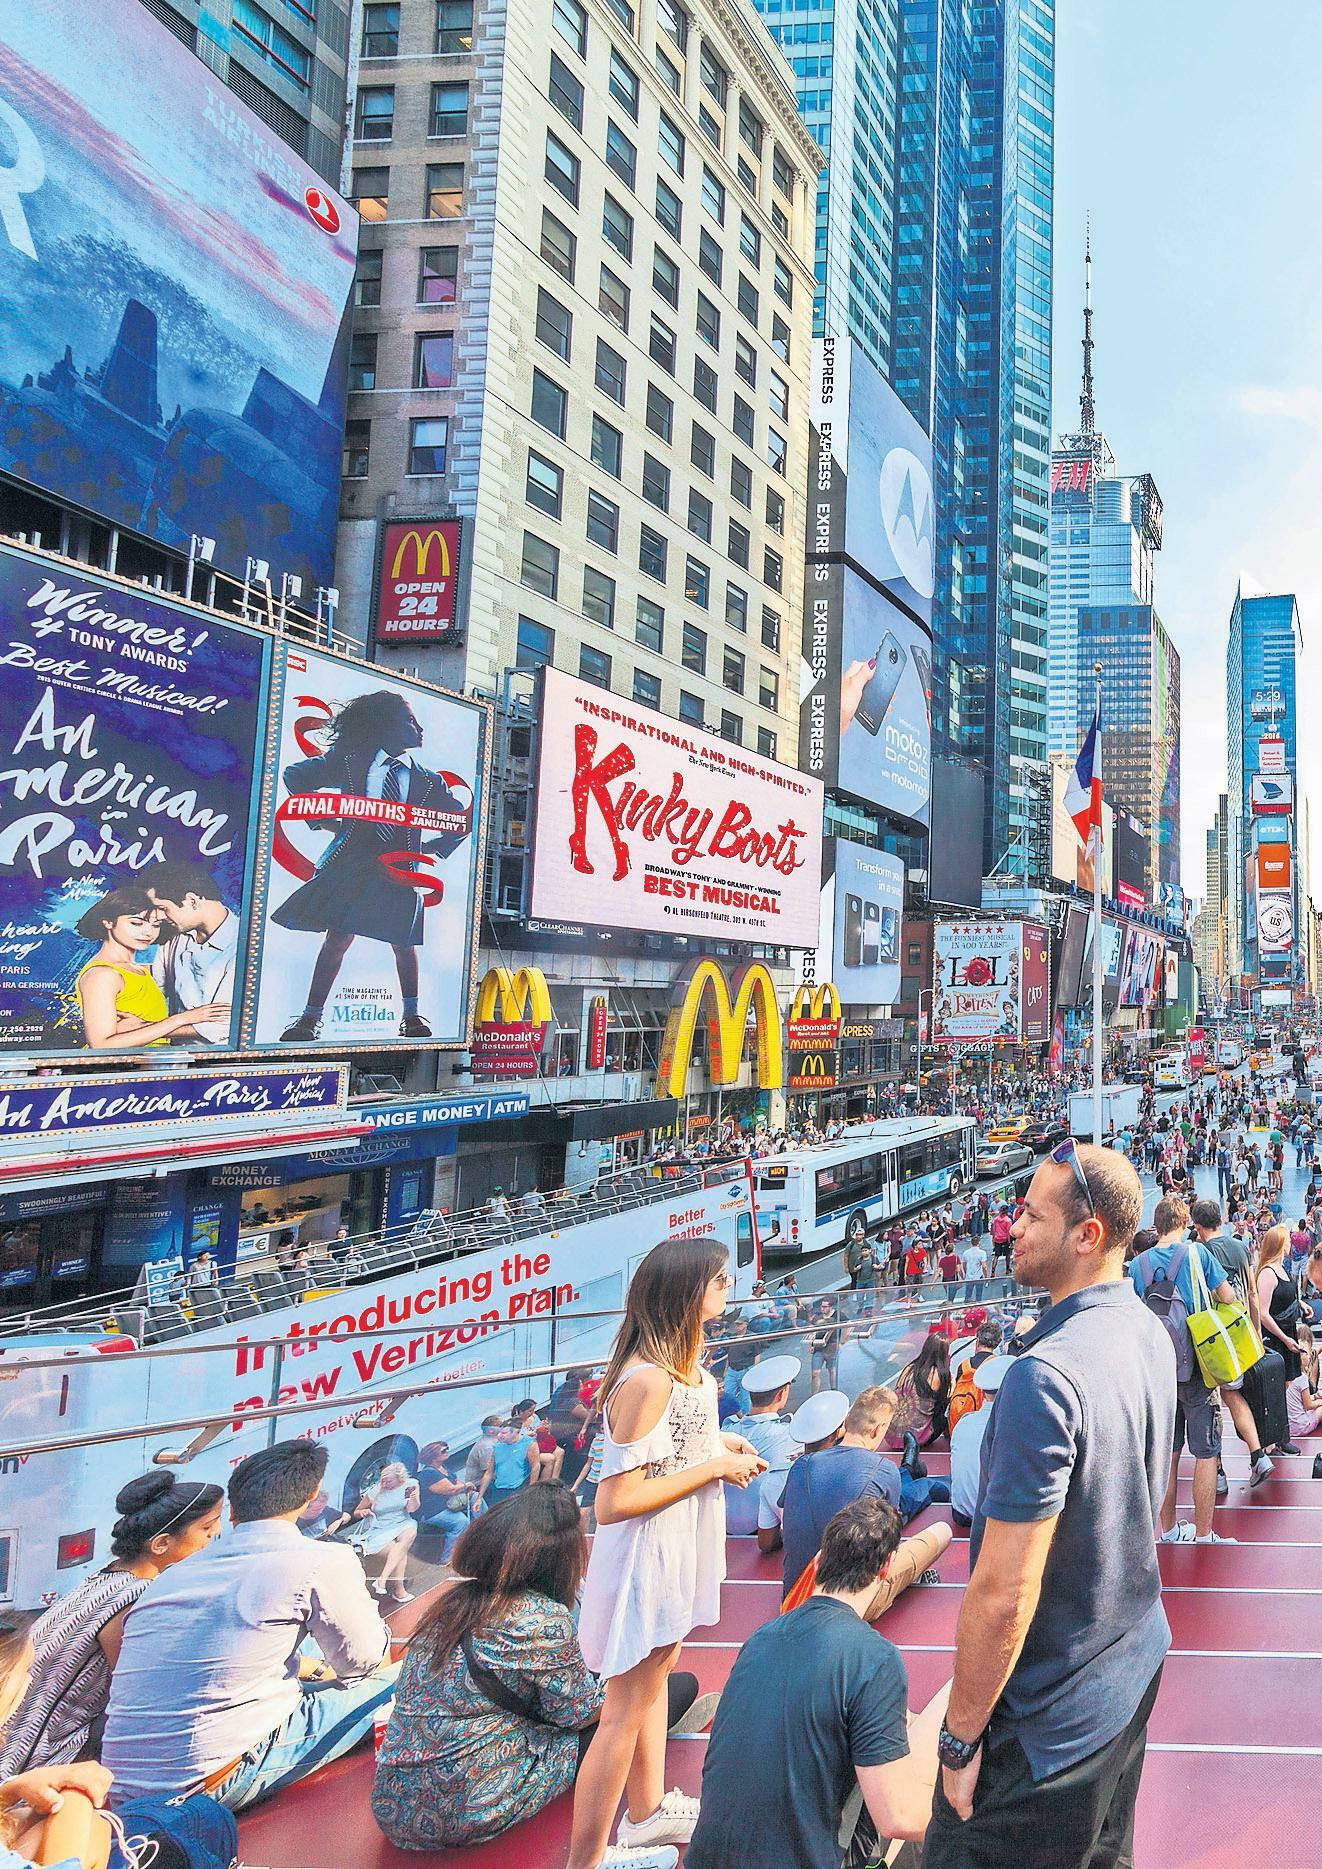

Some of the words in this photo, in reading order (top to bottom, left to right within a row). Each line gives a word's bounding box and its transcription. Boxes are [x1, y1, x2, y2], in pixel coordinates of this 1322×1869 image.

[205, 86, 300, 185] TURKISH
[202, 107, 299, 200] AIRLINES
[823, 338, 834, 403] EXPRESS
[817, 422, 831, 491] EXPRESS
[395, 582, 445, 594] OPEN
[398, 597, 438, 615] 24
[27, 578, 209, 656] Winner!
[385, 619, 449, 631] HOURS
[31, 617, 64, 638] 4
[69, 628, 116, 653] TONY
[120, 643, 188, 673] AWARDS
[812, 599, 828, 679] EXPRESS
[0, 642, 91, 681] Best
[95, 667, 229, 714] Musical!
[52, 678, 72, 688] OUTER
[97, 689, 117, 700] CIRCLE
[123, 696, 142, 706] DRAMA
[143, 700, 162, 710] LEAGUE
[1255, 691, 1280, 702] 5:29
[12, 686, 98, 759] An
[809, 694, 825, 770] EXPRESS
[886, 725, 923, 758] moto
[699, 760, 709, 769] New
[701, 746, 725, 765] AND
[101, 806, 128, 820] in
[287, 798, 335, 815] FINAL
[339, 799, 406, 821] MONTHS
[411, 807, 427, 818] SEE
[427, 811, 435, 819] IT
[436, 811, 466, 823] BEFORE
[568, 723, 714, 882] Kinky
[708, 800, 807, 876] Boots
[410, 817, 459, 830] JANUARY
[0, 811, 166, 879] Paris
[645, 864, 692, 878] BROADWAY'S
[693, 874, 711, 882] TONY
[856, 859, 891, 878] Transform
[60, 888, 109, 901] Musical
[644, 874, 699, 900] BEST
[703, 885, 781, 914] MUSICAL
[1, 922, 63, 938] heart
[0, 966, 31, 974] PARIS
[947, 955, 1008, 988] LOL
[1027, 985, 1043, 1007] CATS
[331, 1004, 395, 1022] Matilda
[473, 1032, 541, 1042] McDonald's
[789, 1024, 838, 1032] McDonald's
[946, 1043, 995, 1052] LUGGAGE
[507, 1061, 534, 1069] HOURS
[293, 1074, 323, 1092] New
[40, 1088, 195, 1129] American
[202, 1079, 272, 1111] Paris
[281, 1087, 326, 1108] Musical
[421, 1104, 486, 1123] MONEY
[493, 1100, 526, 1114] ATM
[211, 1176, 281, 1186] EXCHANGE
[221, 1166, 268, 1175] MONEY
[384, 1167, 392, 1193] MONEY
[192, 1203, 224, 1212] CHANGE
[668, 1207, 706, 1229] Better
[668, 1220, 717, 1240] matters.
[235, 1276, 493, 1377] Introducing
[501, 1253, 551, 1286] the
[353, 1301, 500, 1385] Verizon
[508, 1282, 580, 1320] Plan.
